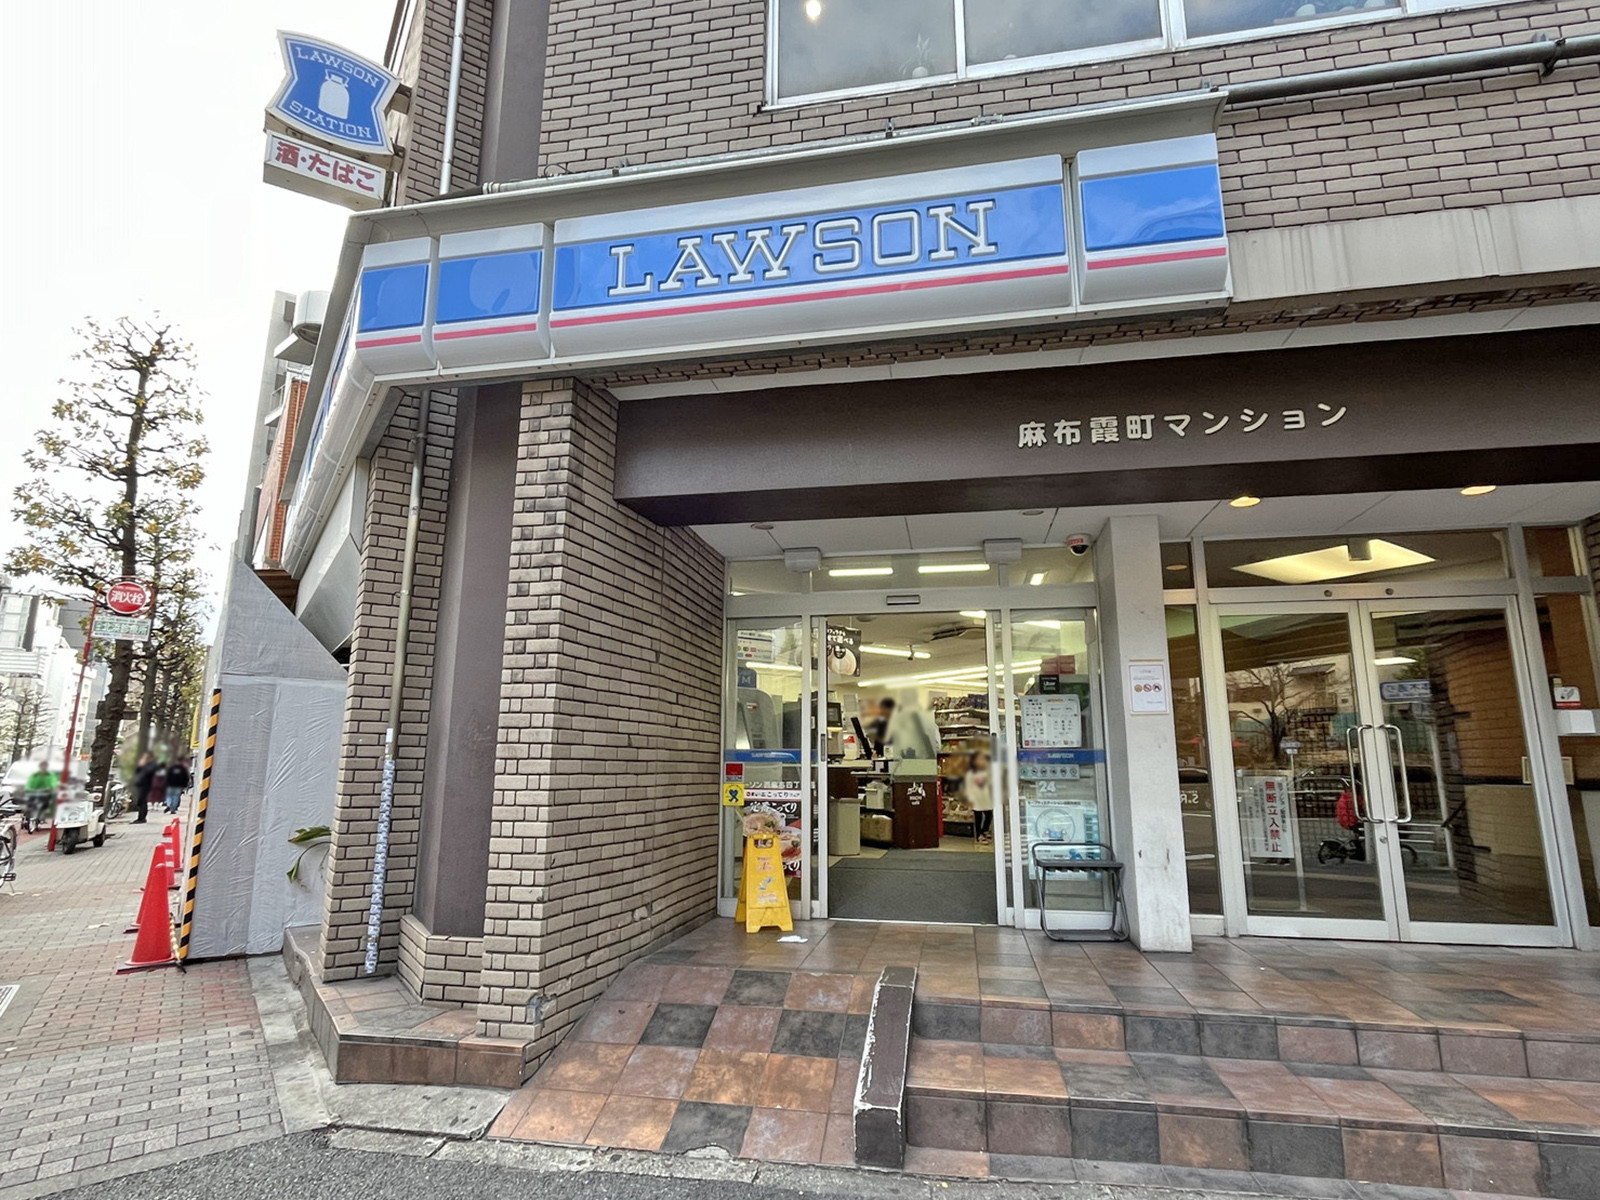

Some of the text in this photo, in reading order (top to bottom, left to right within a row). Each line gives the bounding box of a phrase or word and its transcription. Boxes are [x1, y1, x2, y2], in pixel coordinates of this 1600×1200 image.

[296, 46, 380, 88] LAWSON
[289, 99, 373, 139] STATION
[275, 141, 376, 192] 酒・たばこ
[607, 198, 998, 298] LAWSON
[1018, 403, 1348, 447] 麻布霞町マンション
[110, 589, 145, 605] 消火栓
[1038, 780, 1057, 793] 24
[1264, 781, 1283, 853] 無断立入禁止
